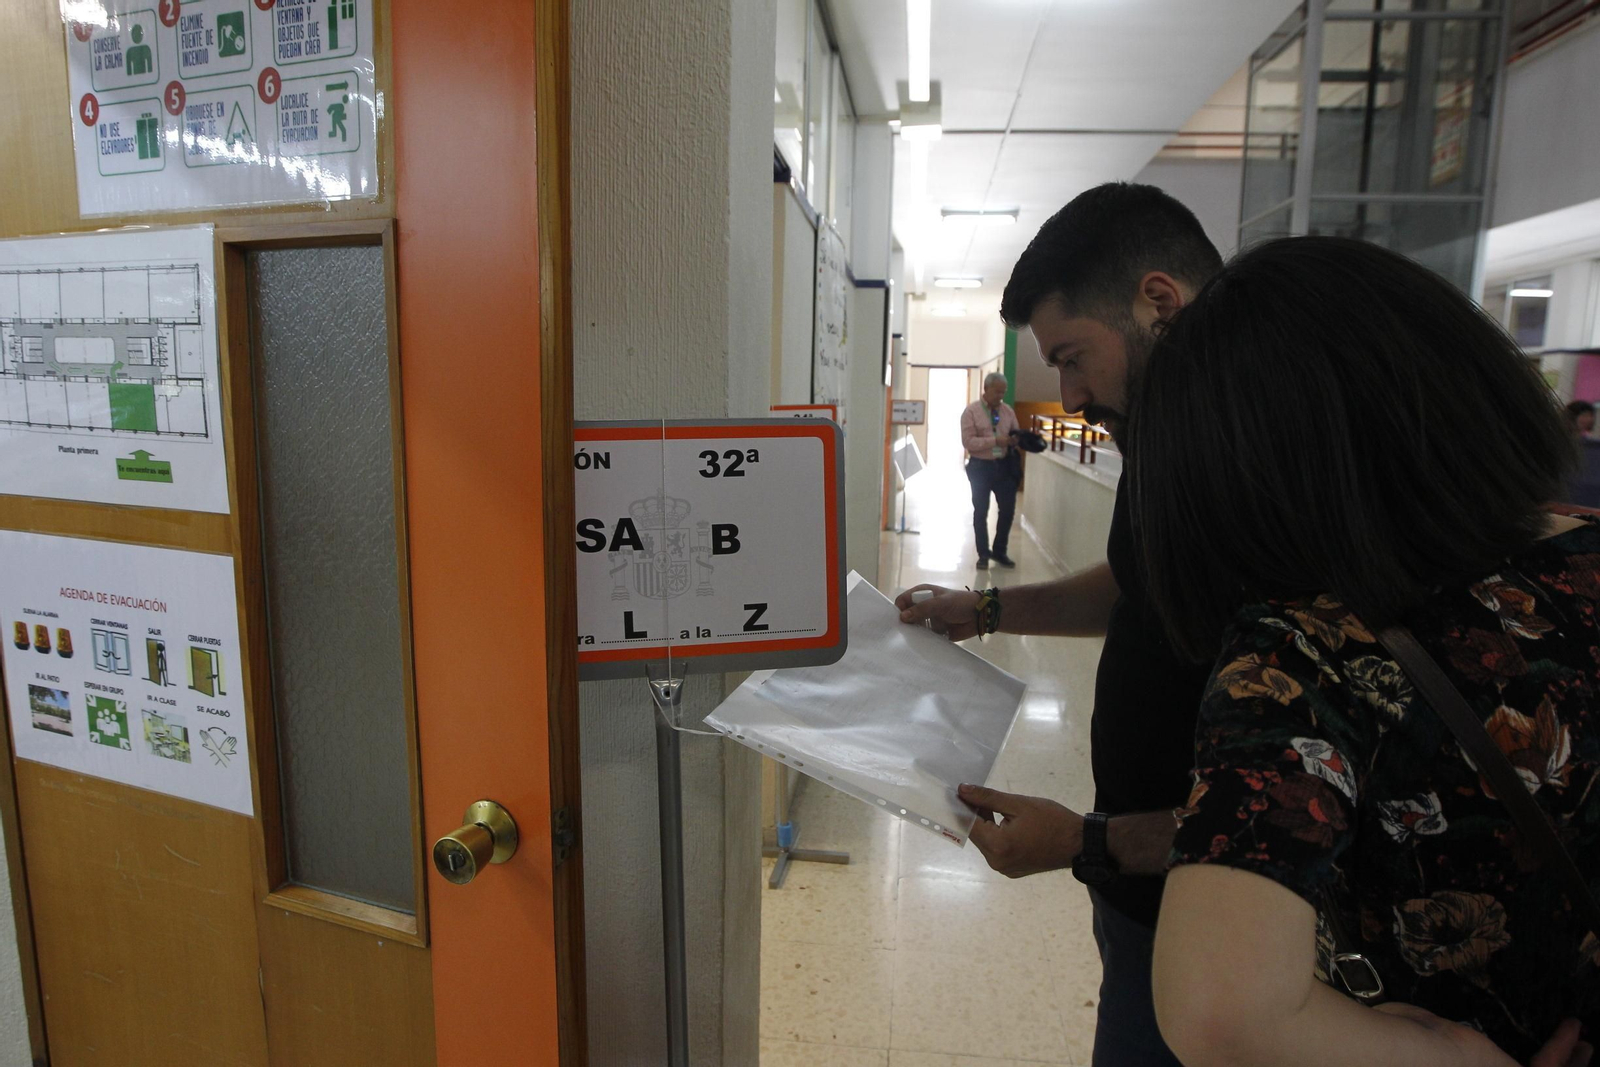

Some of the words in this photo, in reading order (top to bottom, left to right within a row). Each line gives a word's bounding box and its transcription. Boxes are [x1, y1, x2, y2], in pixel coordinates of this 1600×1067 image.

[166, 0, 174, 20] 2
[276, 7, 304, 26] VENTANA
[306, 5, 312, 21] Y
[180, 13, 204, 32] ELIMINE
[277, 24, 304, 42] OBJETOS
[307, 21, 320, 38] QUE
[94, 35, 121, 54] CONSERVE
[181, 30, 203, 49] FUENTE
[206, 29, 214, 46] DE
[278, 41, 302, 59] PUEDAN
[305, 38, 321, 55] CAER
[94, 55, 102, 71] LA
[104, 52, 123, 70] CALMA
[182, 48, 209, 67] INCENDIO
[264, 75, 275, 97] 6
[171, 88, 180, 109] 5
[280, 92, 309, 110] LOCALICE
[85, 101, 93, 119] 4
[216, 101, 225, 117] EN
[281, 111, 289, 127] LA
[292, 109, 308, 126] RUTA
[310, 108, 319, 124] DE
[99, 123, 107, 138] NO
[110, 121, 120, 137] USE
[100, 137, 135, 155] ELEVADORES
[58, 445, 75, 454] Planta
[77, 447, 99, 455] primera
[574, 448, 610, 471] ÓN
[576, 517, 644, 553] SA
[711, 523, 741, 555] B
[59, 587, 95, 602] AGENDA
[96, 592, 108, 604] DE
[110, 594, 167, 613] EVACUACIÓN
[147, 627, 162, 636] SALIR
[577, 633, 595, 645] ra
[623, 610, 648, 639] L
[680, 628, 690, 639] a
[696, 626, 711, 638] la
[742, 602, 769, 632] Z
[187, 634, 203, 643] CERRAR
[204, 637, 221, 646] PUERTAS
[147, 694, 153, 702] IR
[159, 697, 177, 706] CLASE
[196, 705, 205, 713] SE
[206, 708, 231, 718] ACABÓ
